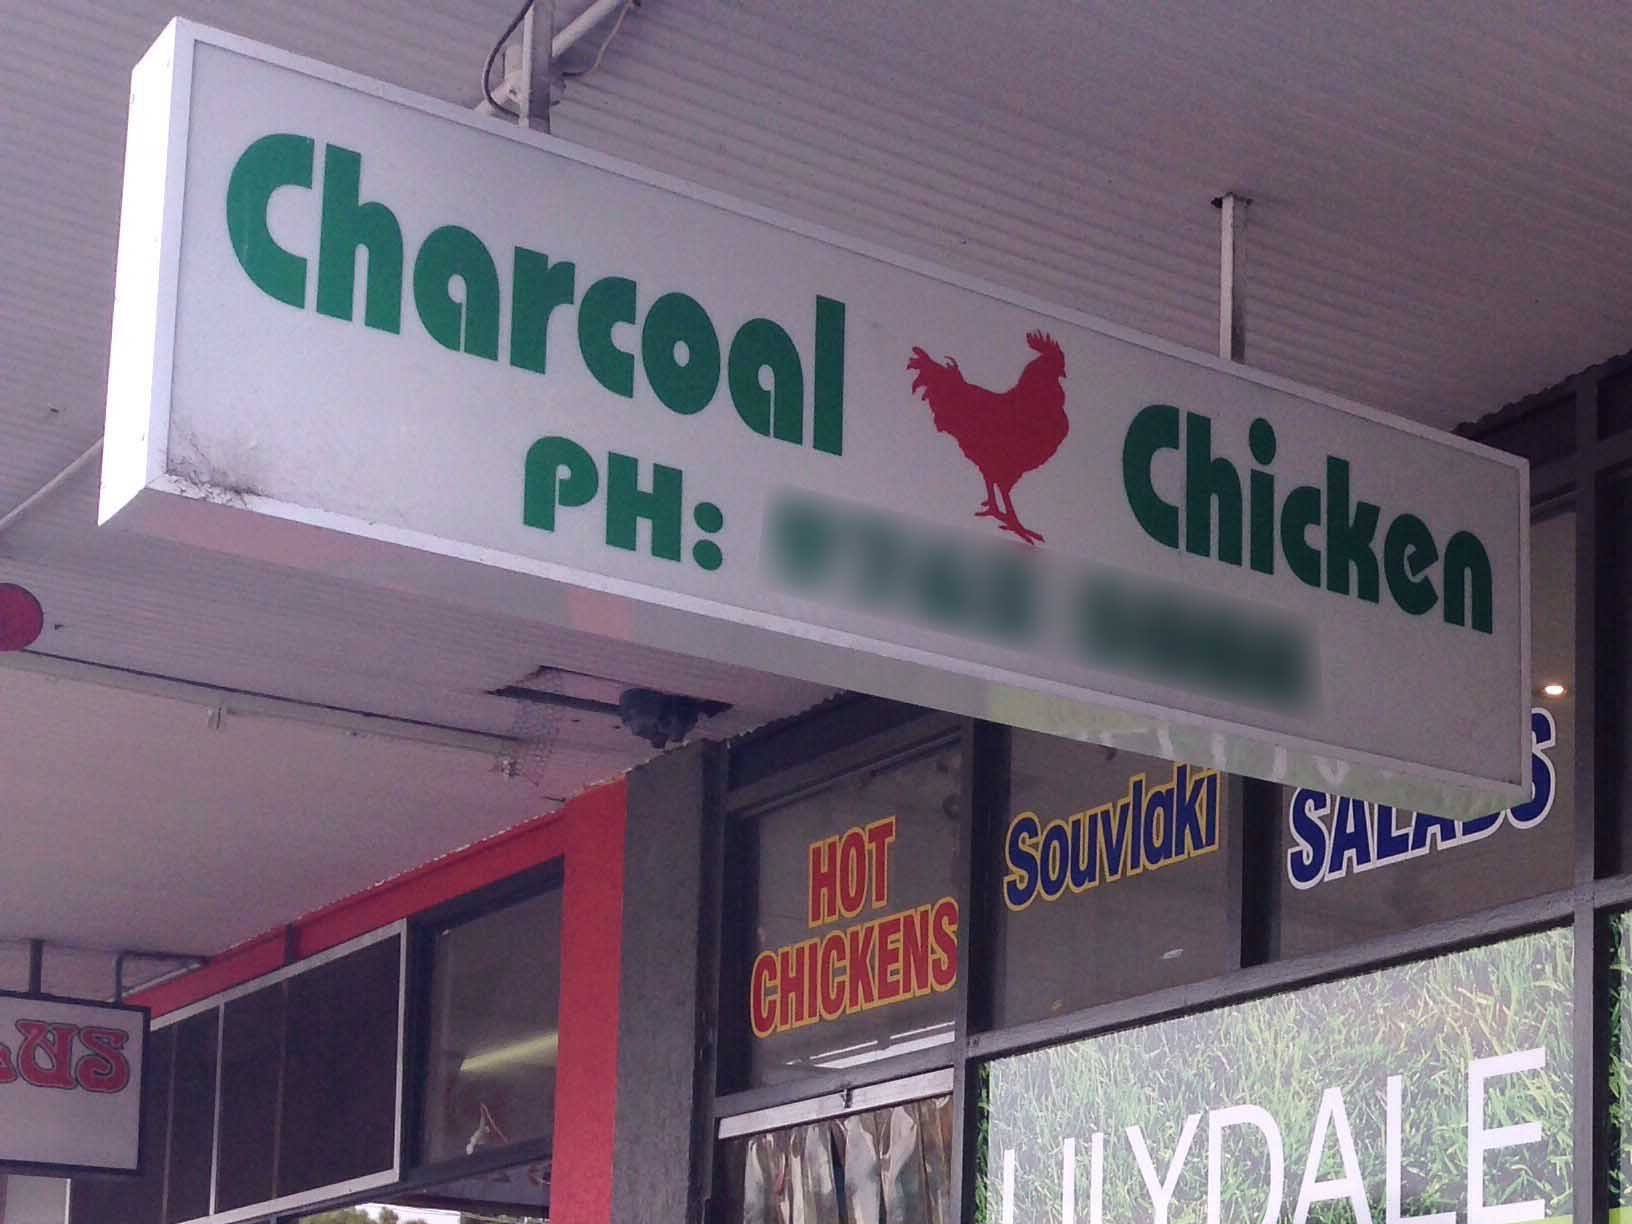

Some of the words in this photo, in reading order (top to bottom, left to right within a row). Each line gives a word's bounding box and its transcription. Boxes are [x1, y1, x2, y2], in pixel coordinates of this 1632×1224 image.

[226, 132, 846, 456] Charcoal
[1122, 403, 1494, 635] Chicken
[523, 436, 723, 572] PH:
[808, 816, 896, 929] HOT
[1003, 761, 1221, 912] Souvlaki
[750, 896, 959, 1039] CHICKENS
